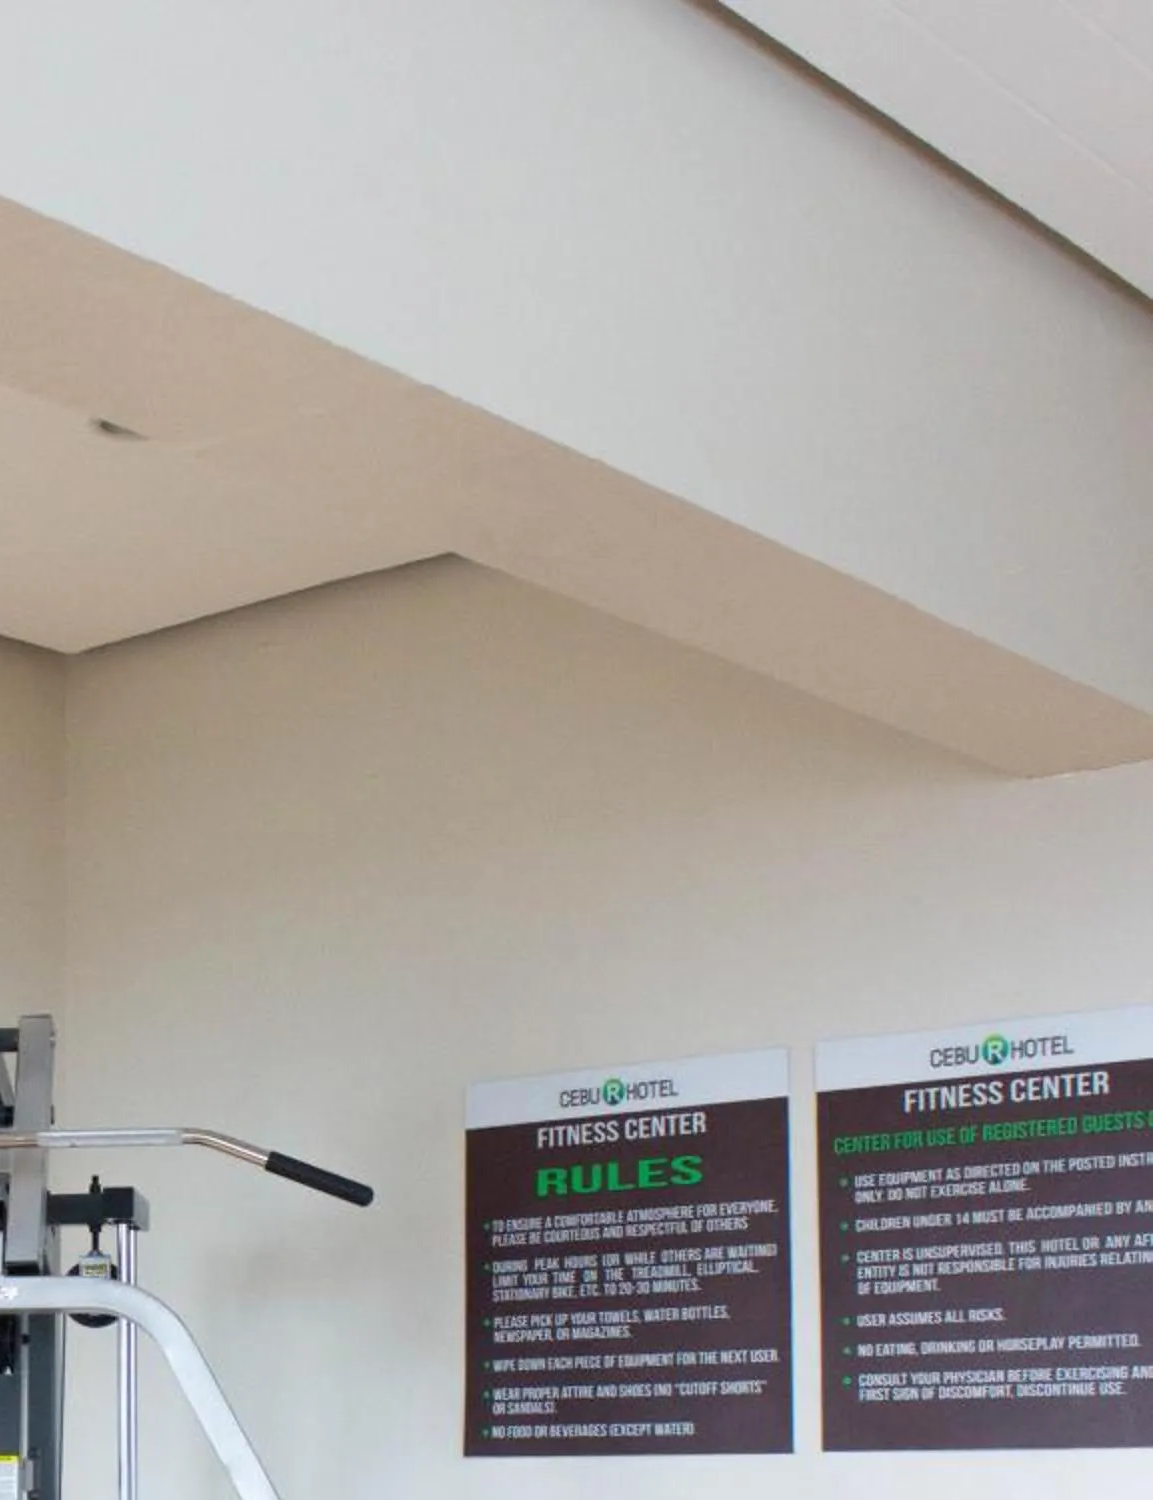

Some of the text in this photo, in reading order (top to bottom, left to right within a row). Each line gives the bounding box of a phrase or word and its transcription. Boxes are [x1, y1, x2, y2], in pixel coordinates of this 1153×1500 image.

[930, 1036, 1075, 1068] CEBU R HOTEL
[559, 1079, 679, 1108] CEBU R HOTEL
[904, 1071, 1109, 1114] FITNESS CENTER
[537, 1111, 707, 1149] FITNESS CENTER
[834, 1133, 892, 1154] CENTER
[894, 1130, 923, 1149] FOR
[926, 1127, 956, 1147] USE
[959, 1125, 978, 1145] OF
[982, 1117, 1078, 1142] REGISTERED
[1082, 1110, 1146, 1134] GUESTS
[536, 1155, 704, 1197] RULES
[855, 1174, 877, 1188] USE
[878, 1169, 943, 1187] EQUIPMENT
[946, 1168, 961, 1181] AS
[963, 1162, 1021, 1180] DIRECTED
[1022, 1161, 1040, 1175] ON
[1043, 1159, 1067, 1173] THE
[1068, 1155, 1116, 1172] POSTED
[887, 1188, 903, 1202] DO
[905, 1186, 928, 1200] NOT
[930, 1181, 987, 1198] EXERCISE
[627, 1204, 694, 1222] ATMOSPHERE
[697, 1203, 717, 1218] FOR
[855, 1216, 911, 1232] CHILDREN
[912, 1213, 952, 1228] UNDER
[956, 1211, 969, 1225] 14
[971, 1209, 1004, 1224] MUST
[1007, 1207, 1024, 1221] BE
[1026, 1201, 1114, 1220] ACCOMPANIED
[1115, 1200, 1132, 1215] BY
[492, 1231, 528, 1247] PLEASE
[602, 1225, 624, 1239] AND
[625, 1220, 688, 1237] RESPECTFUL
[534, 1257, 559, 1270] PEAK
[661, 1248, 703, 1263] OTHERS
[857, 1249, 899, 1263] CENTER
[902, 1248, 914, 1261] IS
[1009, 1239, 1036, 1254] THIS
[1040, 1237, 1079, 1252] HOTEL
[1082, 1236, 1100, 1250] OR
[1104, 1234, 1131, 1249] ANY
[522, 1272, 549, 1286] YOUR
[552, 1270, 576, 1284] TIME
[605, 1267, 624, 1281] THE
[898, 1263, 911, 1277] IS
[912, 1262, 936, 1277] NOT
[938, 1257, 1016, 1275] RESPONSIBLE
[1018, 1255, 1042, 1270] FOR
[494, 1315, 529, 1330] PLEASE
[530, 1313, 553, 1328] PICK
[555, 1312, 569, 1326] UP
[571, 1311, 597, 1326] YOUR
[644, 1307, 679, 1322] WATER
[856, 1313, 886, 1328] USER
[888, 1311, 943, 1326] ASSUMES
[945, 1309, 966, 1323] ALL
[857, 1343, 874, 1357] NO
[978, 1339, 994, 1353] OR
[996, 1336, 1066, 1352] HORSEPLAY
[548, 1357, 573, 1371] EACH
[575, 1356, 601, 1369] PIECE
[676, 1351, 697, 1365] FOR
[698, 1351, 719, 1365] THE
[720, 1350, 748, 1364] NEXT
[858, 1372, 908, 1387] CONSULT
[910, 1371, 941, 1385] YOUR
[942, 1369, 1005, 1385] PHYSICIAN
[1007, 1368, 1055, 1382] BEFORE
[1056, 1366, 1129, 1381] EXERCISING
[522, 1386, 559, 1400] PROPER
[858, 1386, 891, 1401] FIRST
[1016, 1382, 1097, 1397] DISCONTINUE
